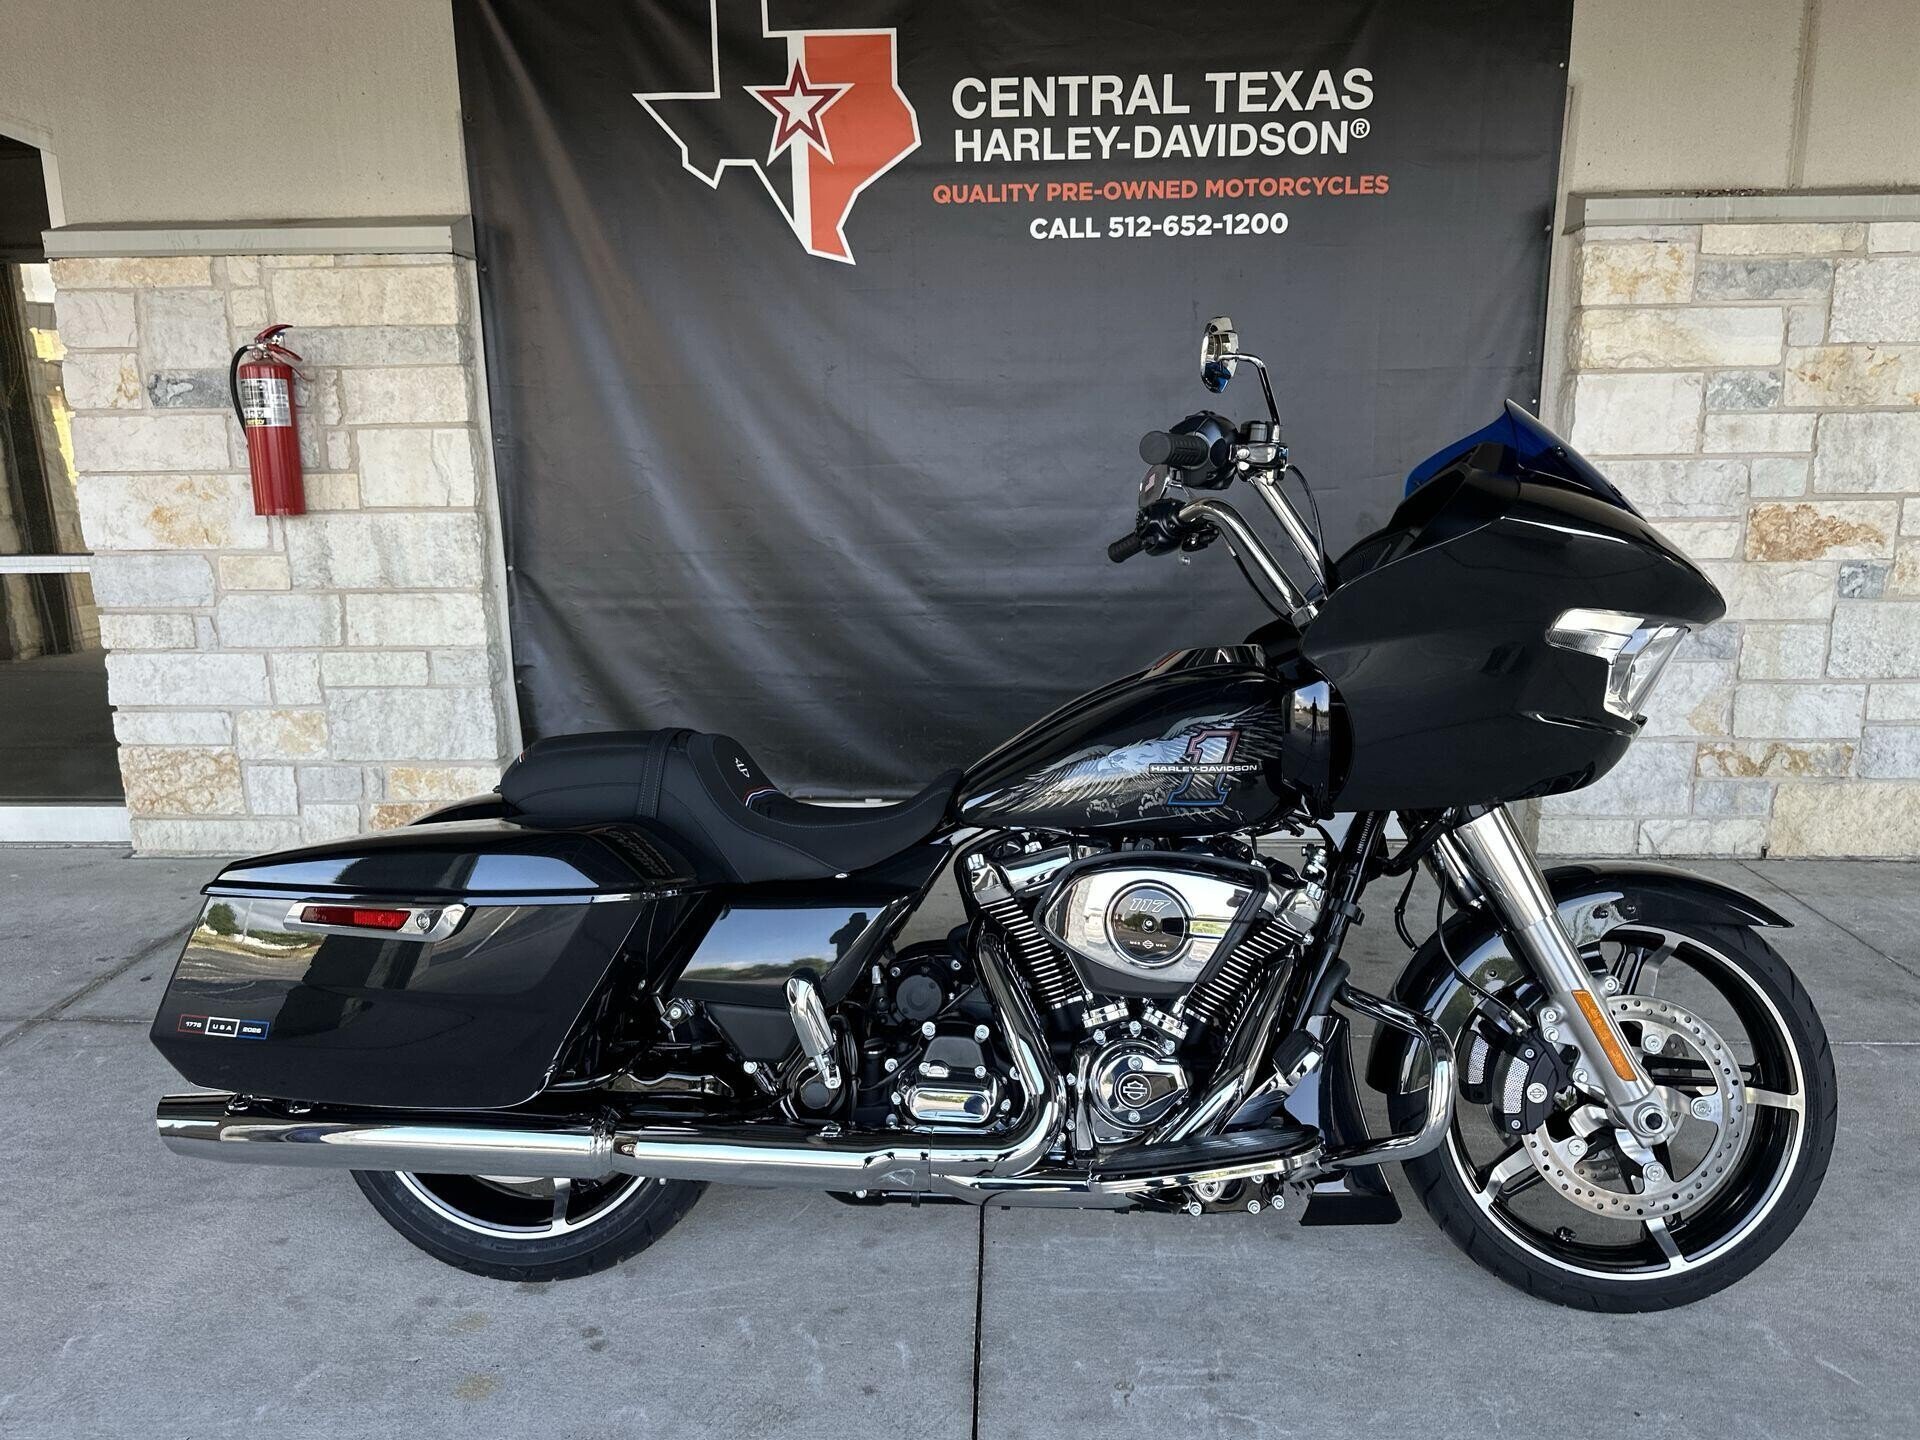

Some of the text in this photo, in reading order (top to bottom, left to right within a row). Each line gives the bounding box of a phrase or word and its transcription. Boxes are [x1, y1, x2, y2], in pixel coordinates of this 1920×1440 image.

[951, 67, 1375, 121] CENTRAL TEXAS
[932, 174, 1390, 205] QUALITY PRE-OWNED MOTORCYCLES
[1029, 211, 1289, 240] CALL 512-652-1200
[1150, 764, 1258, 773] HARLEY-DAVIDSON
[1129, 897, 1171, 913] 117
